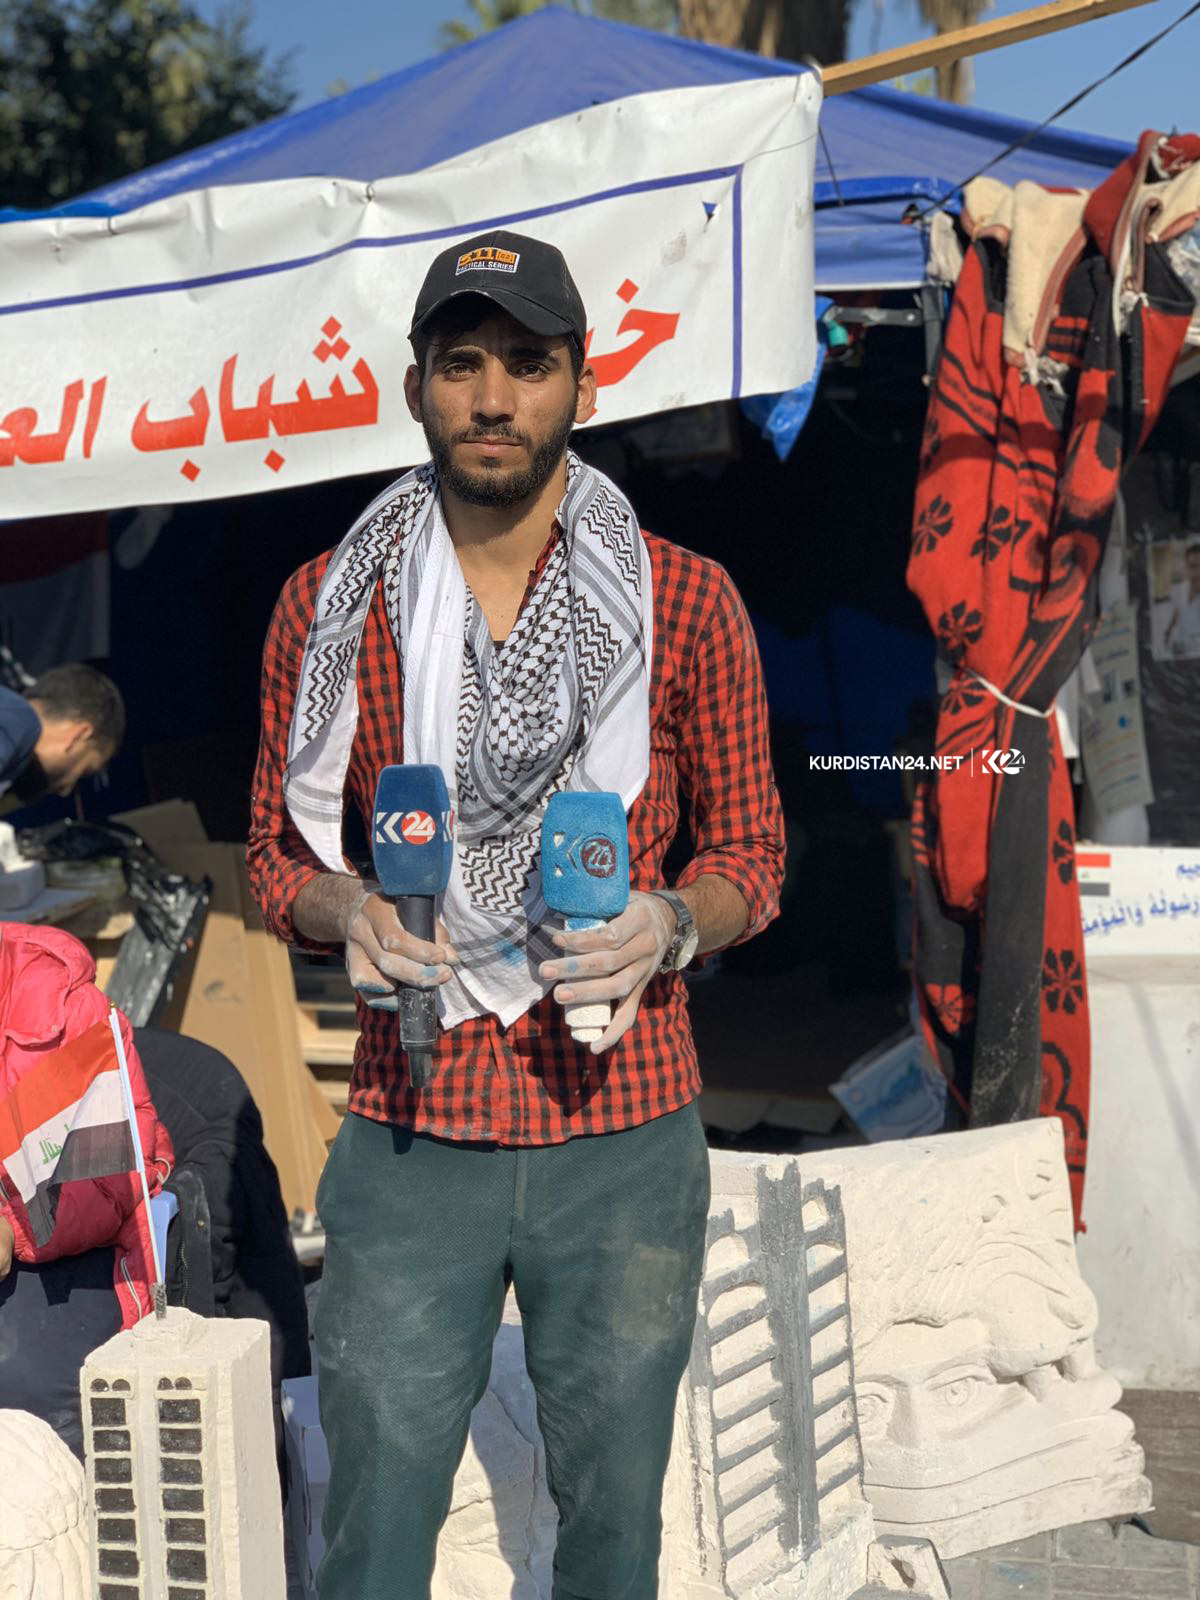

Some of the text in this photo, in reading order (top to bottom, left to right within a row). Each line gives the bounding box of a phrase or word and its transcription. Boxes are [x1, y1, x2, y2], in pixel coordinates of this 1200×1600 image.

[457, 260, 515, 273] TACTICAL SERIES
[0, 315, 379, 482] شباب الع
